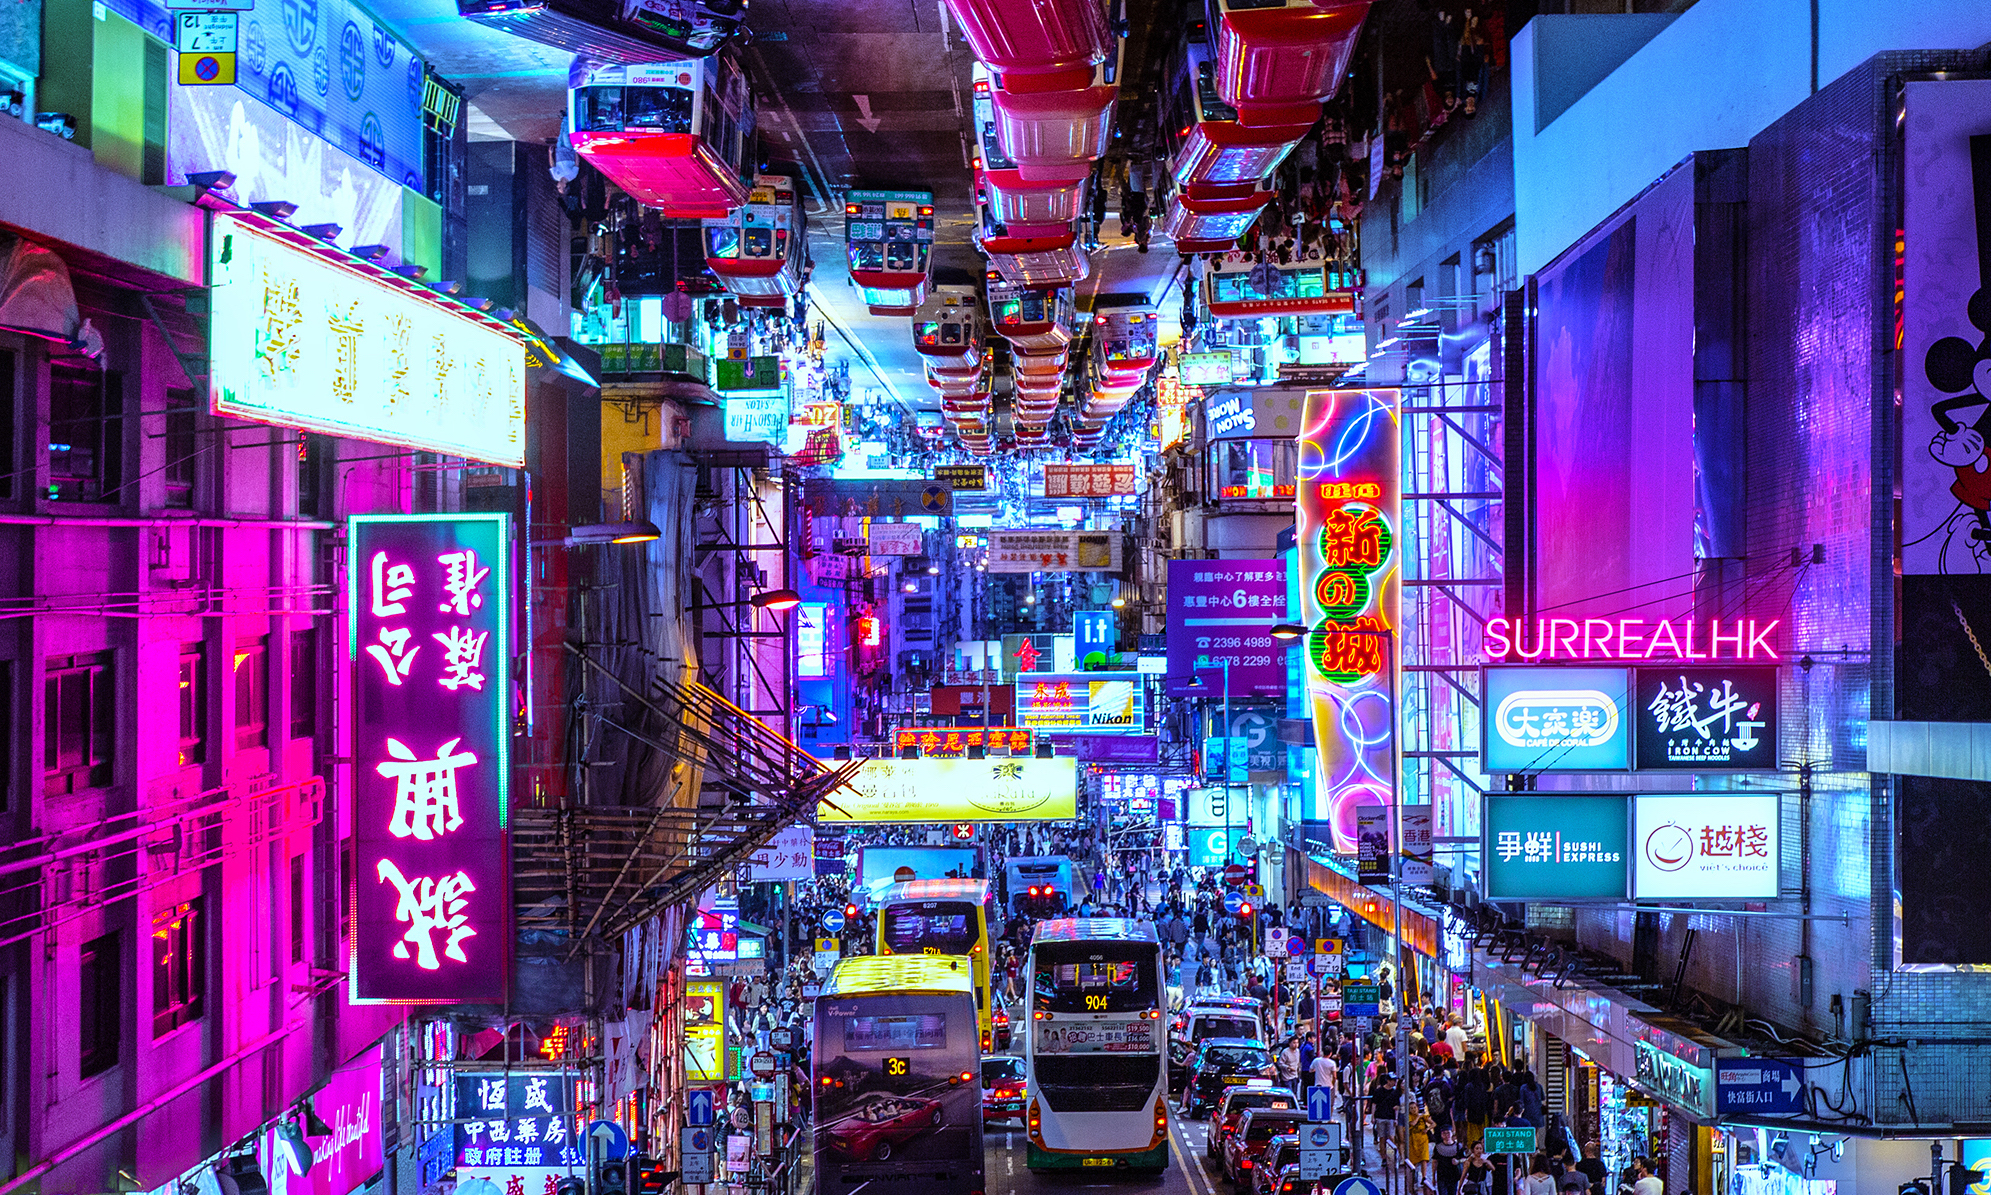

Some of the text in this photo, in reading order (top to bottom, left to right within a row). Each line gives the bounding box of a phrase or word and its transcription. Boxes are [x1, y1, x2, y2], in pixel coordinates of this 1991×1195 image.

[184, 16, 200, 28] 12
[191, 37, 200, 50] 7
[1208, 397, 1241, 422] MORE
[1215, 408, 1256, 435] SALON
[1320, 483, 1381, 499] 旺角
[1317, 508, 1383, 675] 新の城
[366, 551, 421, 686] 公司
[1084, 619, 1107, 643] i.t
[1484, 617, 1780, 659] SURREALHK
[1213, 637, 1272, 648] 2396 4989
[1243, 656, 1271, 666] 2299
[1647, 675, 1748, 738] 鐵牛
[1092, 713, 1133, 724] Nikon
[1668, 747, 1730, 755] IRON COW
[1404, 829, 1432, 843] 香港
[1700, 825, 1769, 858] 越棧
[1563, 842, 1602, 850] SUSHI
[1563, 853, 1621, 862] EXPRESS
[1085, 995, 1109, 1010] 904
[1728, 1090, 1773, 1104] 快富街入口
[464, 1115, 567, 1145] 中西藥房
[1495, 1140, 1525, 1149] 的士站
[1326, 1153, 1333, 1163] 7
[1326, 1167, 1338, 1175] 12
